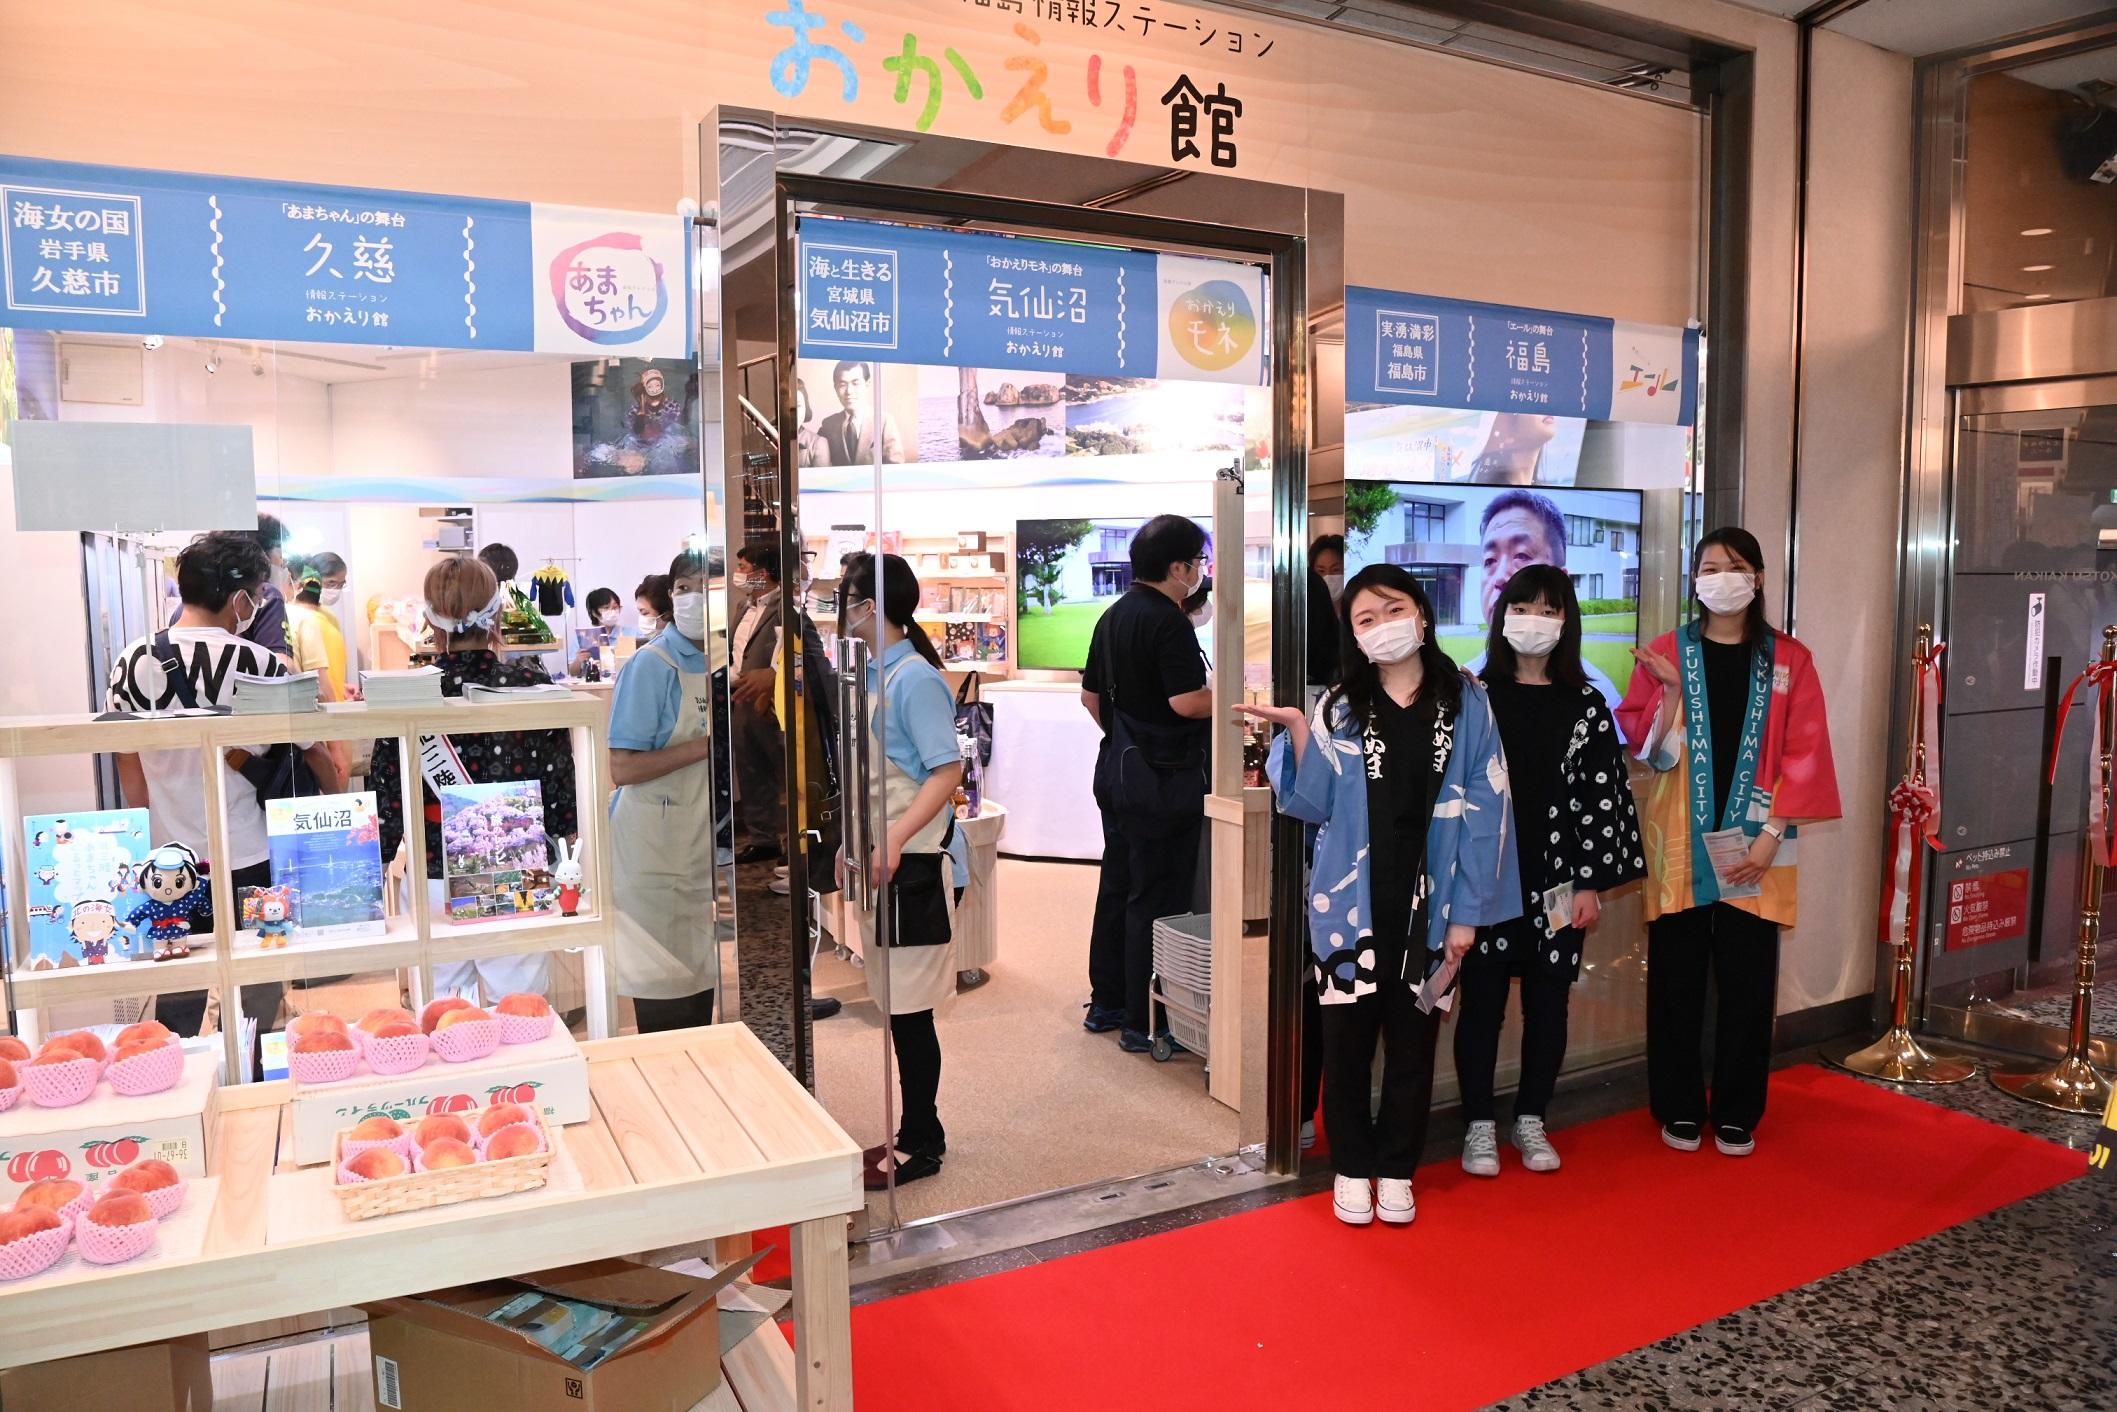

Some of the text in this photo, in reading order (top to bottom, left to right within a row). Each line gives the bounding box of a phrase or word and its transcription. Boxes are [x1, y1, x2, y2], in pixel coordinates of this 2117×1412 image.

[765, 0, 1243, 168] おかえり館
[14, 201, 129, 235] 海女の国
[282, 202, 406, 227] 「あまちゃん」の舞台
[38, 238, 110, 262] 岩手県
[303, 232, 395, 283] 久慈
[809, 256, 892, 281] 海と生きる
[986, 255, 1083, 276] 「おかえりモネ」の舞台
[32, 266, 120, 296] 久慈市
[305, 289, 388, 302] 情報ステーション
[826, 285, 875, 305] 宮城県
[988, 278, 1087, 323] 気仙沼
[306, 306, 389, 327] おかえり館
[810, 307, 891, 333] 気仙沼市
[1186, 300, 1235, 317] おかえり
[1007, 326, 1064, 338] 情報ステーション
[1187, 321, 1238, 355] モネ
[1006, 341, 1064, 358] おかえり館
[1392, 344, 1424, 359] 福島県
[1506, 340, 1550, 374] 福島
[1387, 362, 1428, 382] 福島市
[1510, 389, 1549, 403] おかえり館
[1685, 646, 1708, 826] FUKUSHIMA CITY
[1730, 770, 1751, 822] CITY
[293, 809, 352, 831] 気仙沼
[336, 1095, 429, 1117] フルーツライン
